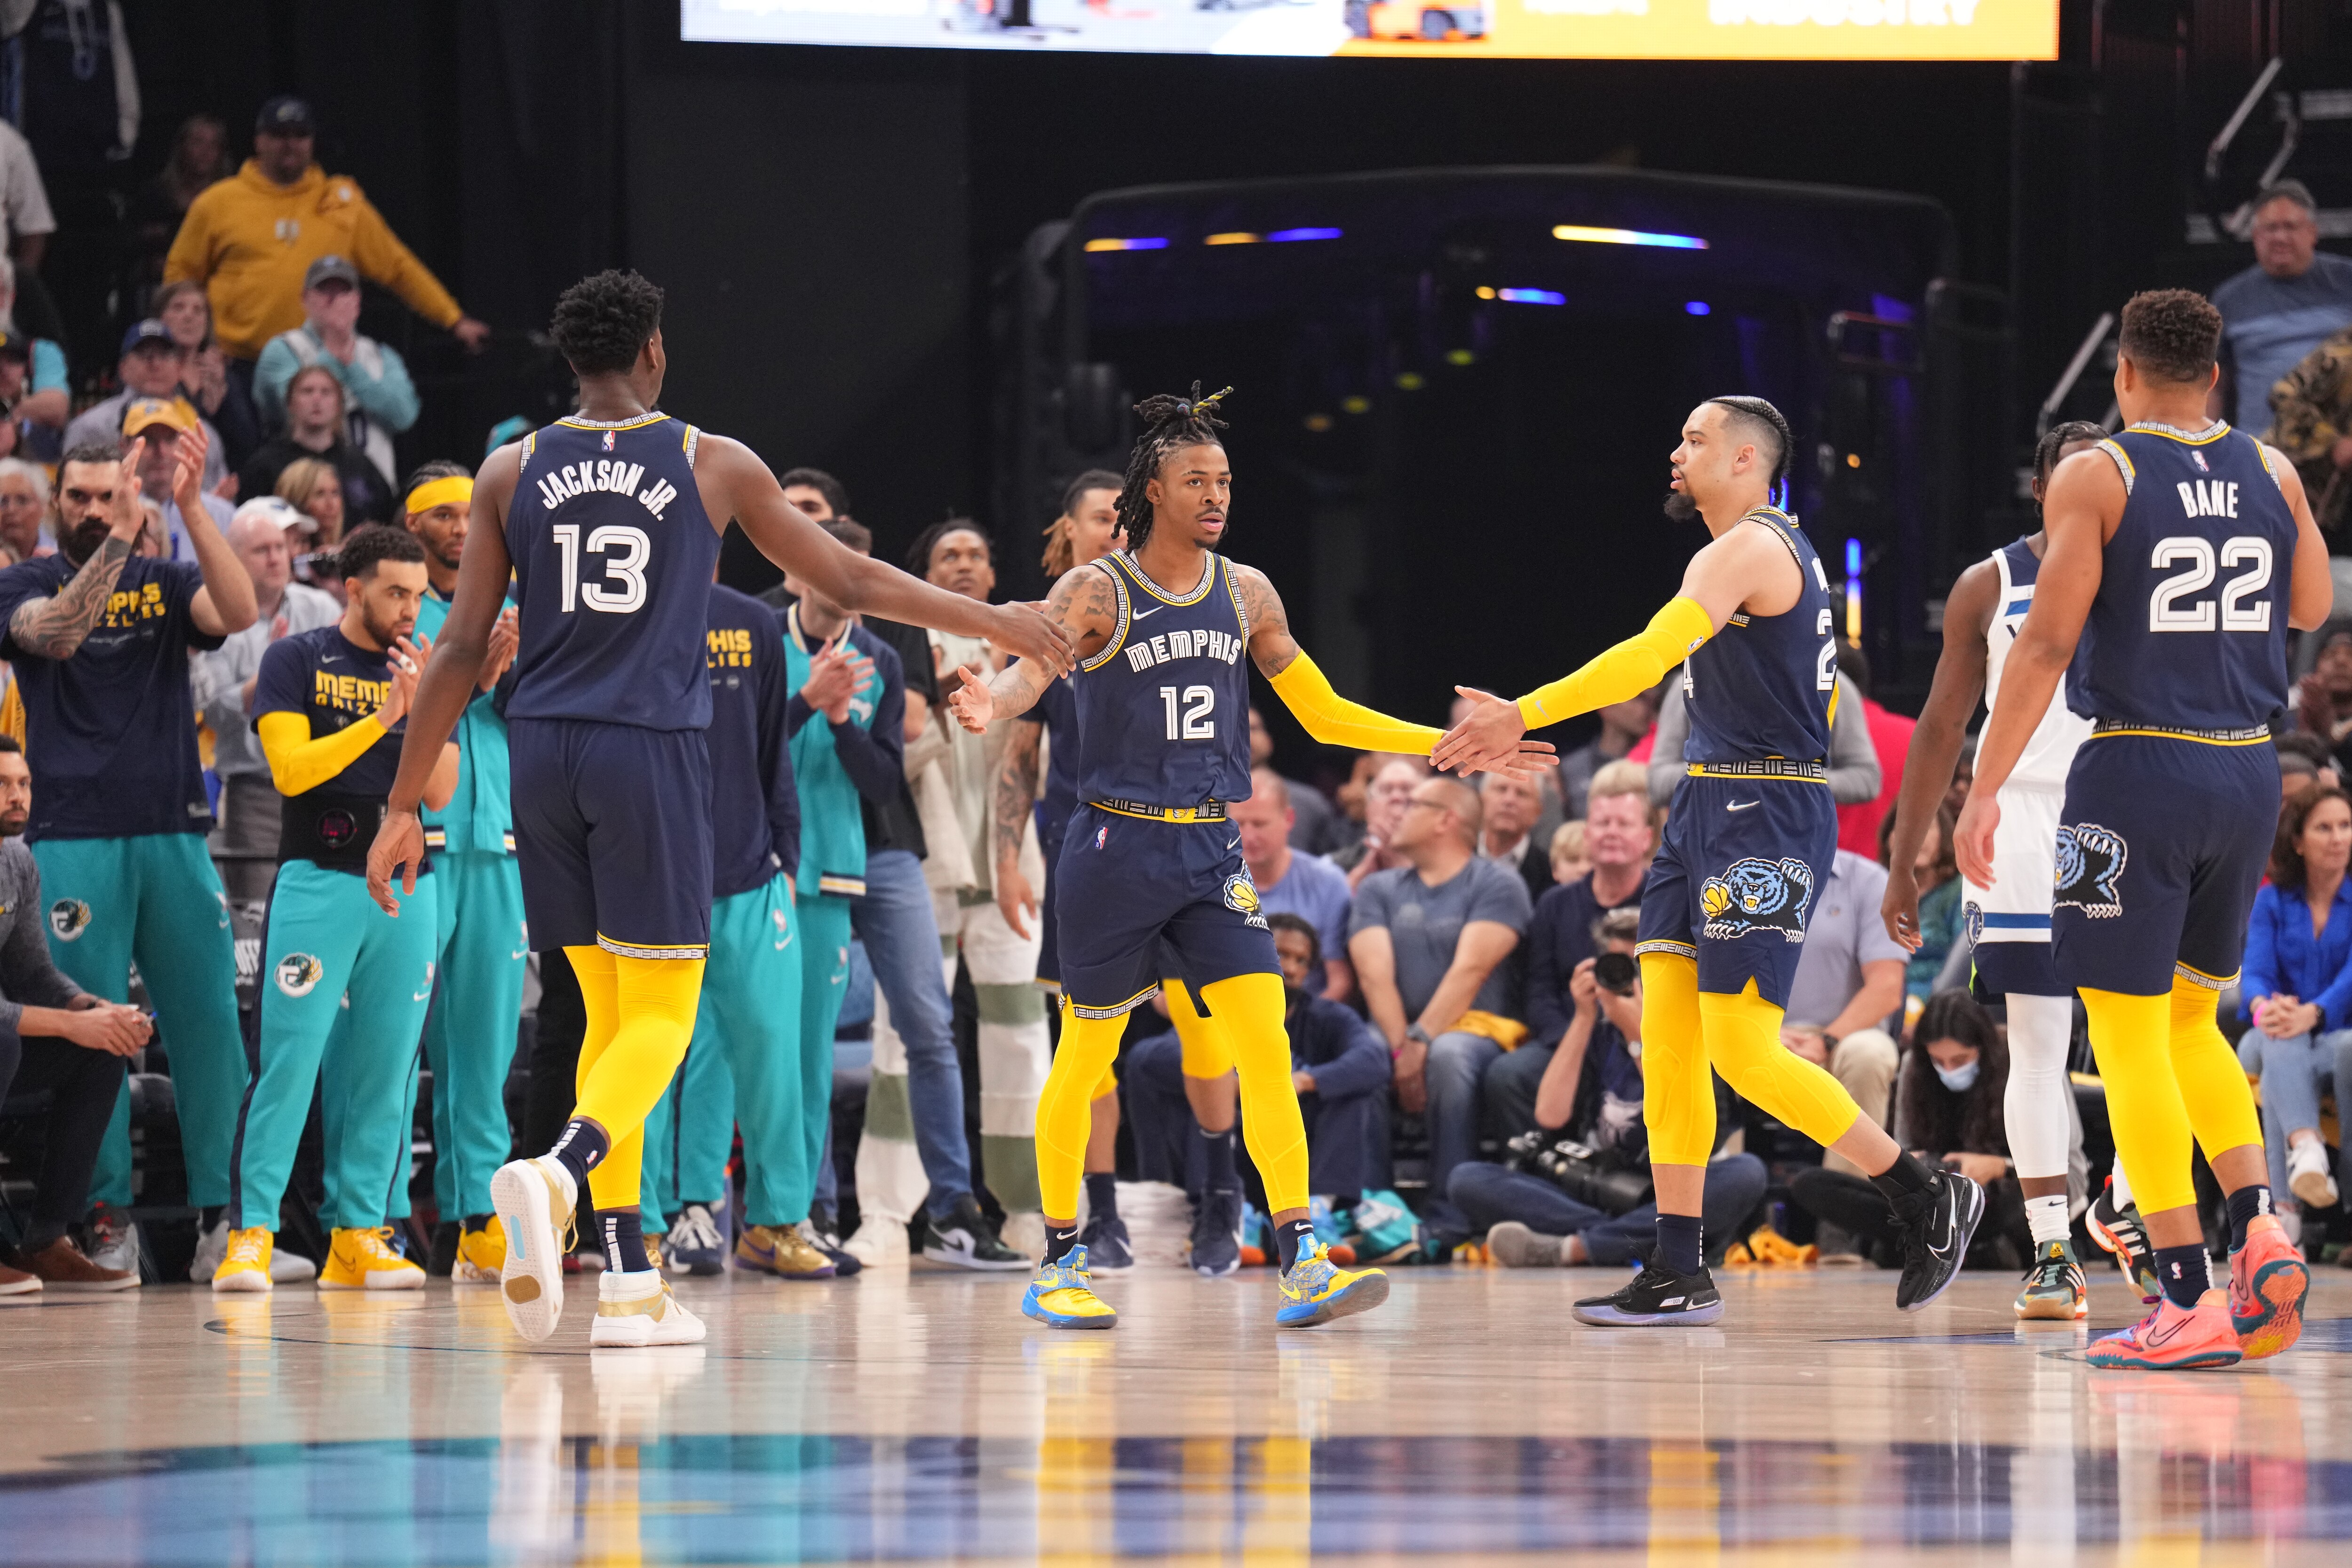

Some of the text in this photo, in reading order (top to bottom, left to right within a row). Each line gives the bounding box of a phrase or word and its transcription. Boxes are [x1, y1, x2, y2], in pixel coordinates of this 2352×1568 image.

[537, 459, 677, 521] JACKSON JR.
[2176, 479, 2238, 519] BANE
[553, 524, 651, 614] 13
[2149, 536, 2273, 633] 22
[1124, 629, 1242, 673] MEMPHIS
[1160, 685, 1215, 740] 12
